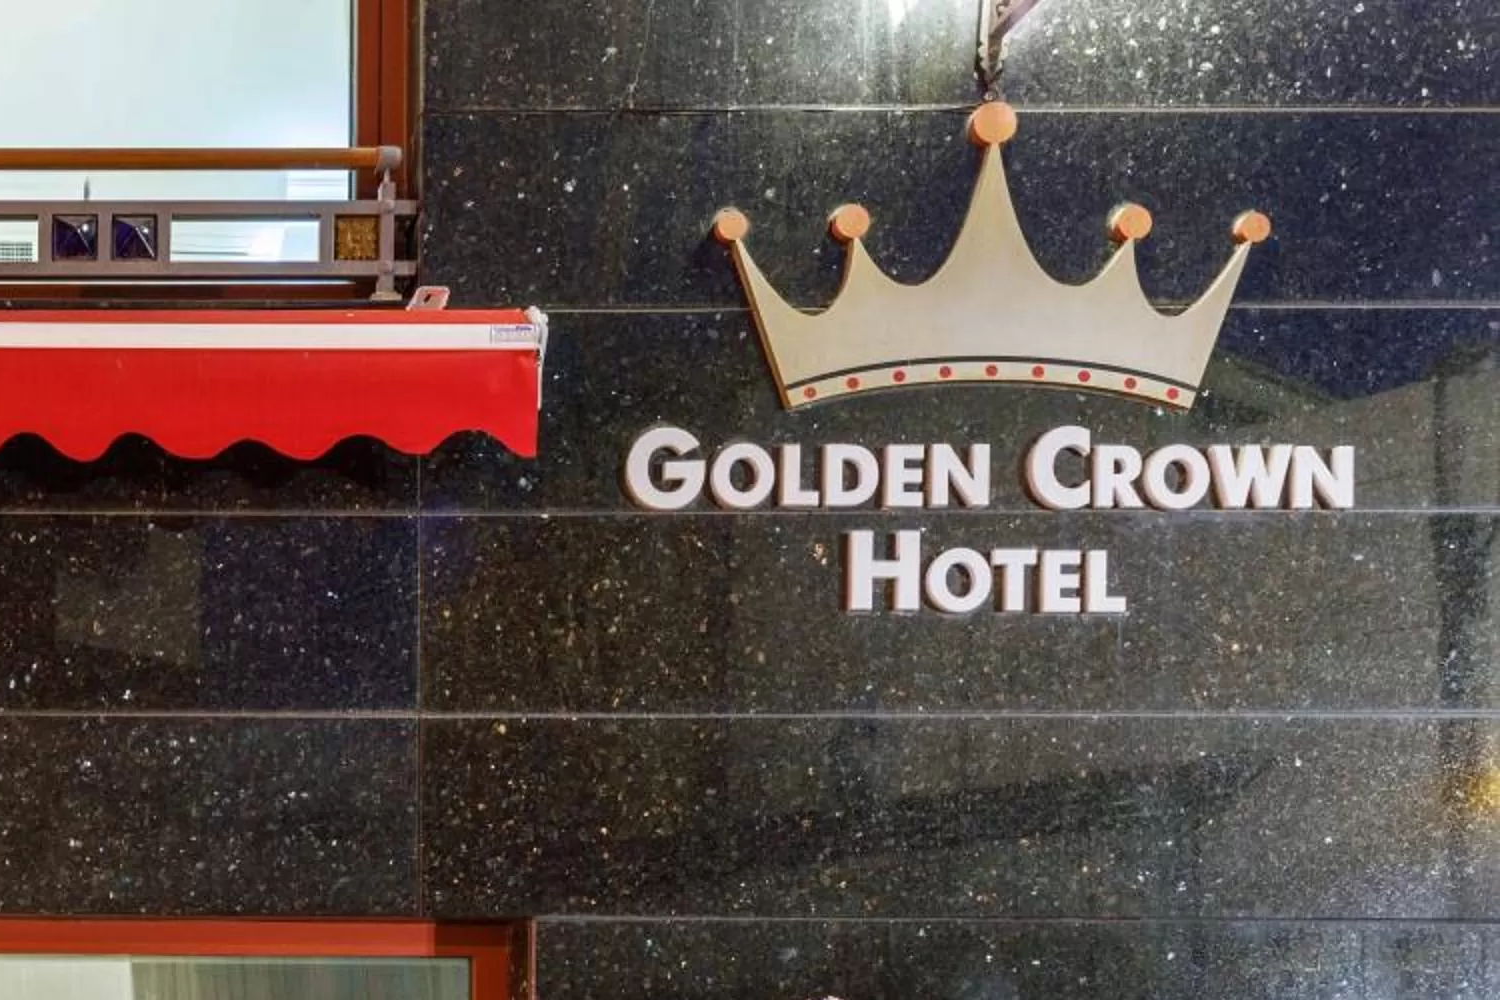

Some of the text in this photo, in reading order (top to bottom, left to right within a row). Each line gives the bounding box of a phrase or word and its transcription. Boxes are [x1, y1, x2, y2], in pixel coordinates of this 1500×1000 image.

[624, 425, 1356, 511] GOLDEN CROWN
[845, 529, 1127, 614] HOTEL
